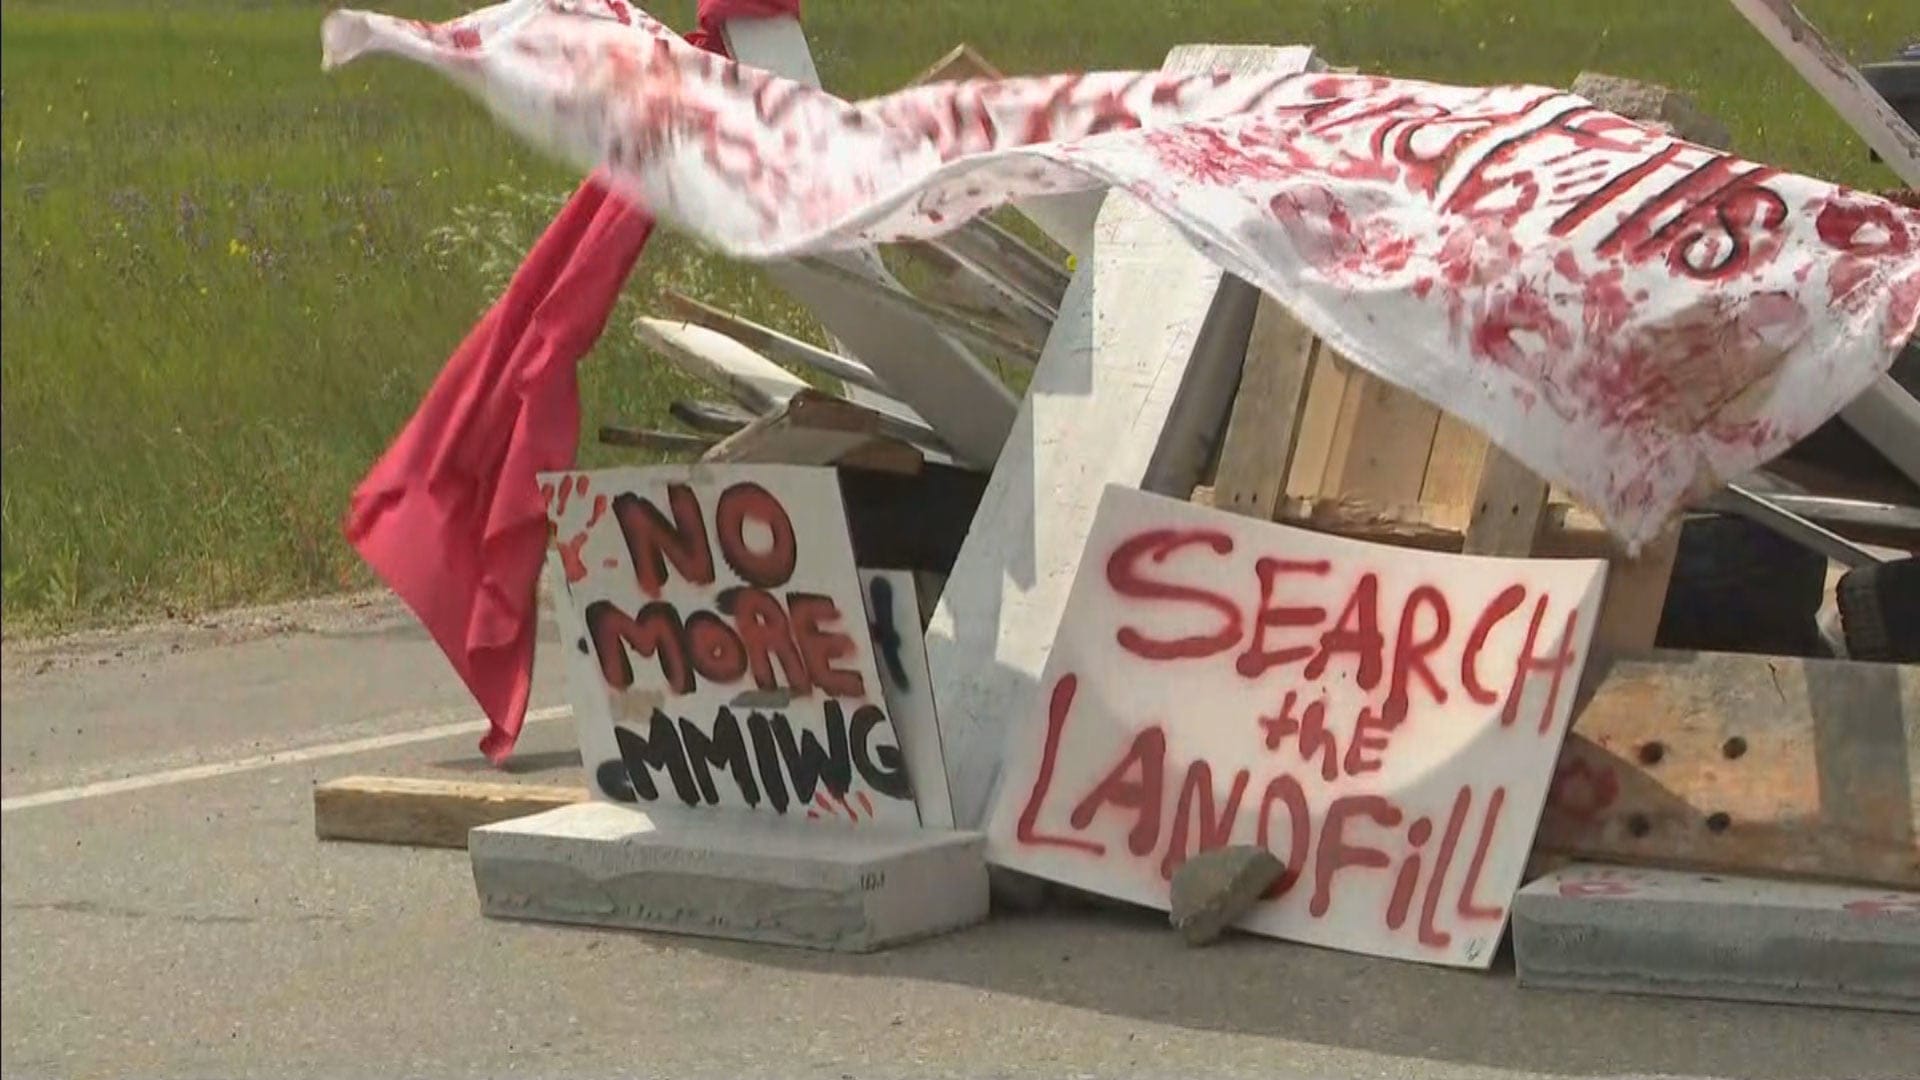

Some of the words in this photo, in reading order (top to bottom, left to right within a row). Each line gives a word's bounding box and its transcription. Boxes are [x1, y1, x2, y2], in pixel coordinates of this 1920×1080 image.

[612, 481, 797, 598] NO
[585, 586, 865, 697] MORE
[1107, 529, 1578, 735] SEARCH
[613, 697, 917, 814] MMIWG
